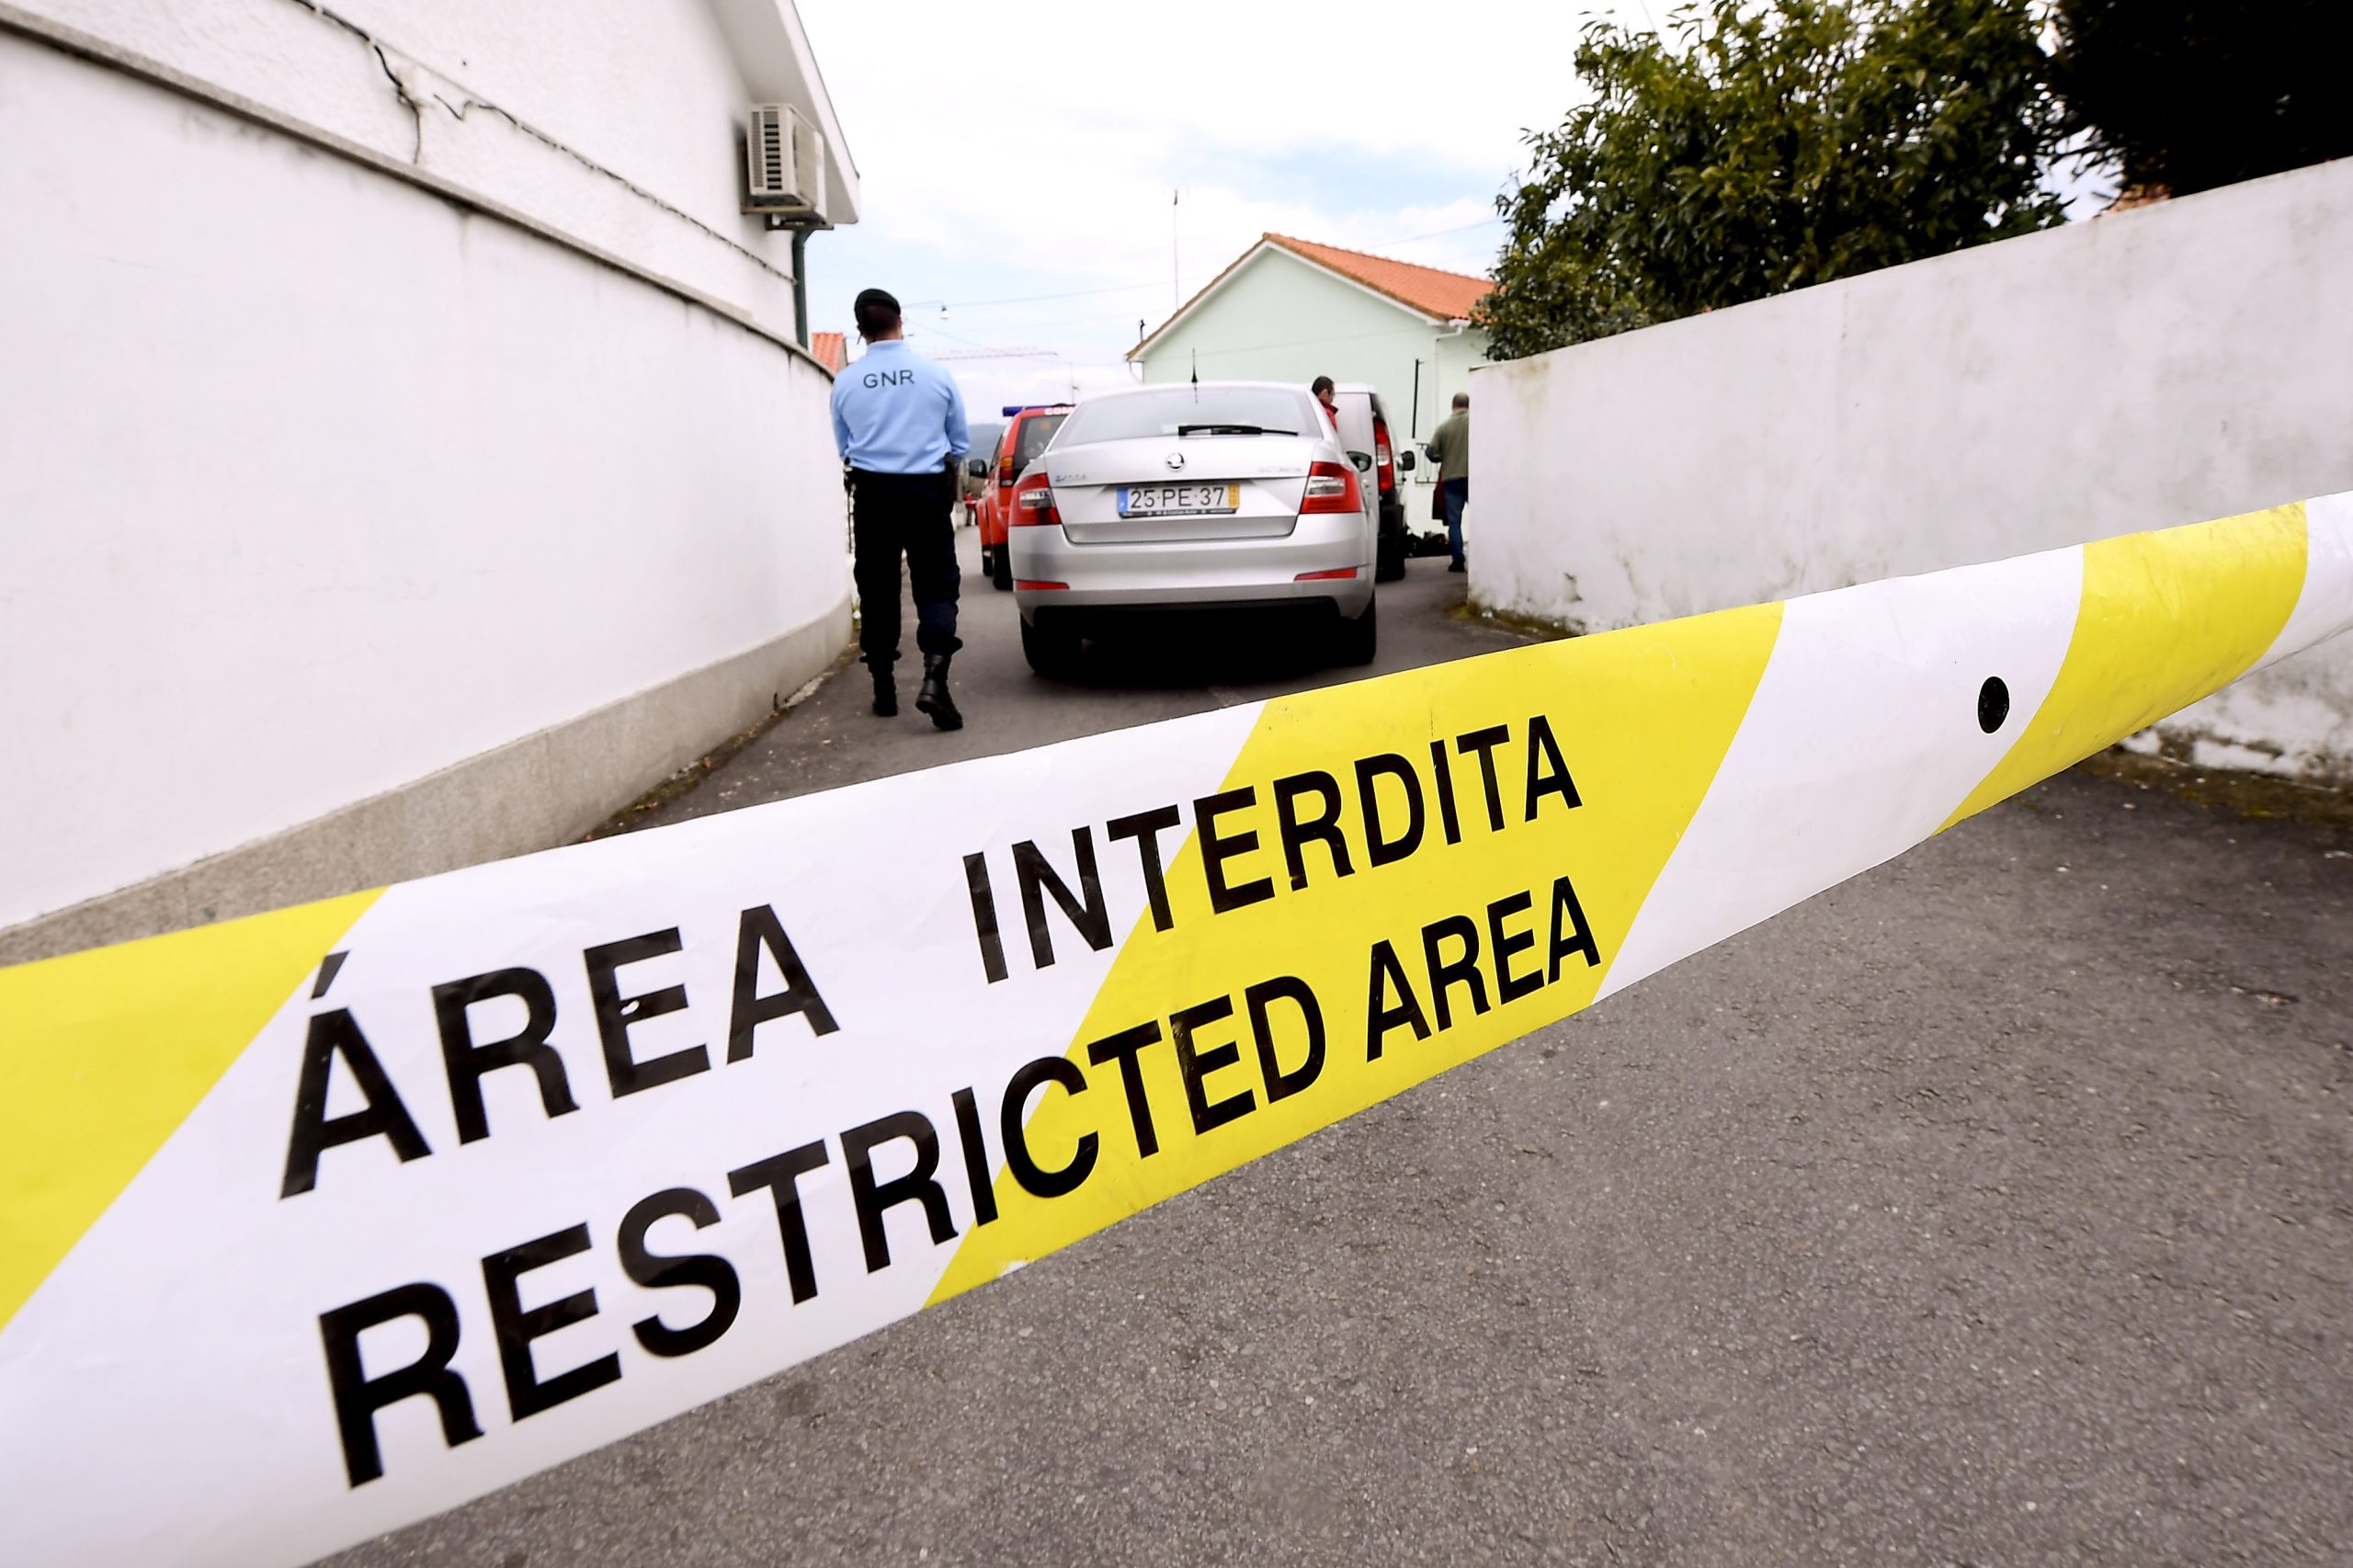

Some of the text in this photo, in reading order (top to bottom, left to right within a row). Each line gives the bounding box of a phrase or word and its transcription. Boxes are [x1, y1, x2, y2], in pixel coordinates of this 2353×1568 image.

[862, 369, 915, 389] GNR
[279, 713, 1583, 1200] ÁREA INTERDITA
[318, 875, 1602, 1489] RESTRICTED AREA
